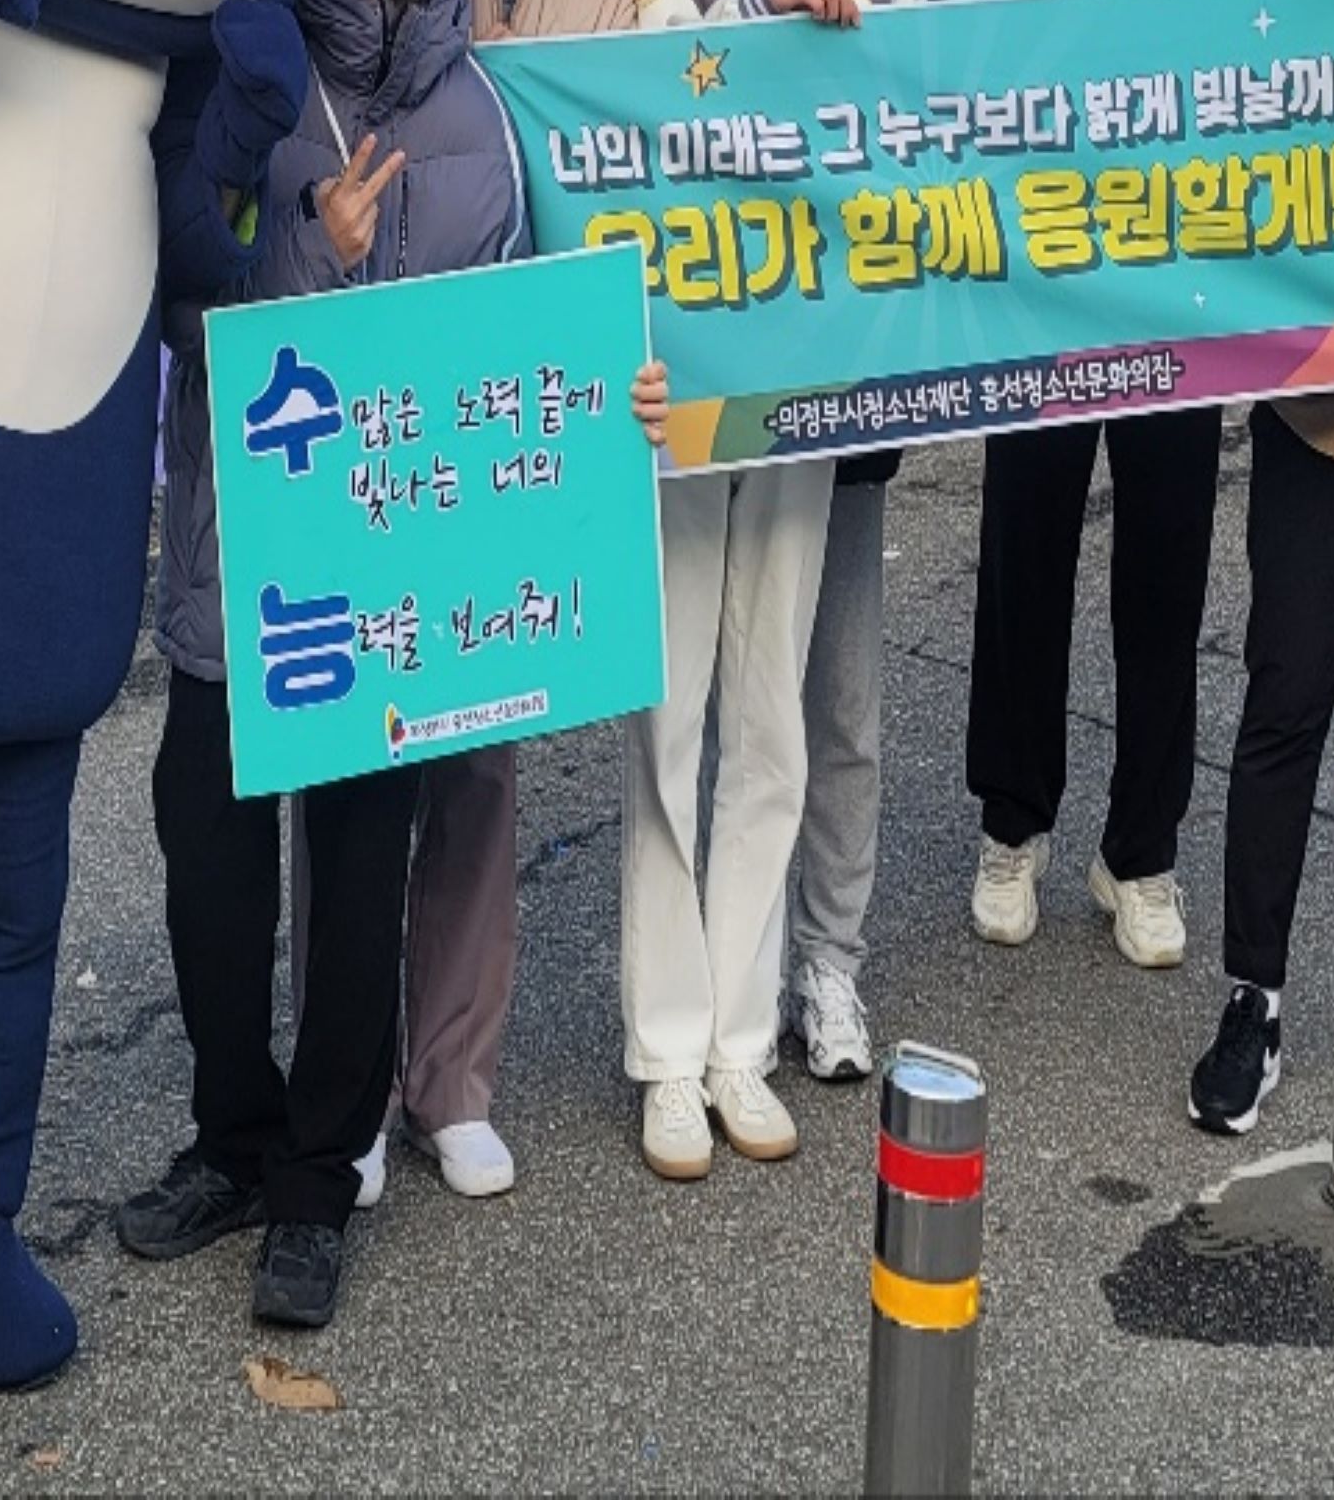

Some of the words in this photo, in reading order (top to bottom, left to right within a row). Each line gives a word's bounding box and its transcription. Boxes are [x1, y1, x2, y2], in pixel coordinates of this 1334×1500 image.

[548, 122, 653, 190] 너의
[659, 113, 811, 180] 미래는
[816, 103, 870, 168] 그
[877, 83, 1077, 162] 누구보다
[1084, 69, 1185, 147] 밝게
[840, 174, 1008, 293] 함께
[456, 376, 521, 437] 노력
[536, 364, 605, 436] 끝에
[351, 453, 459, 531] 빛나는
[493, 452, 563, 493] 너의
